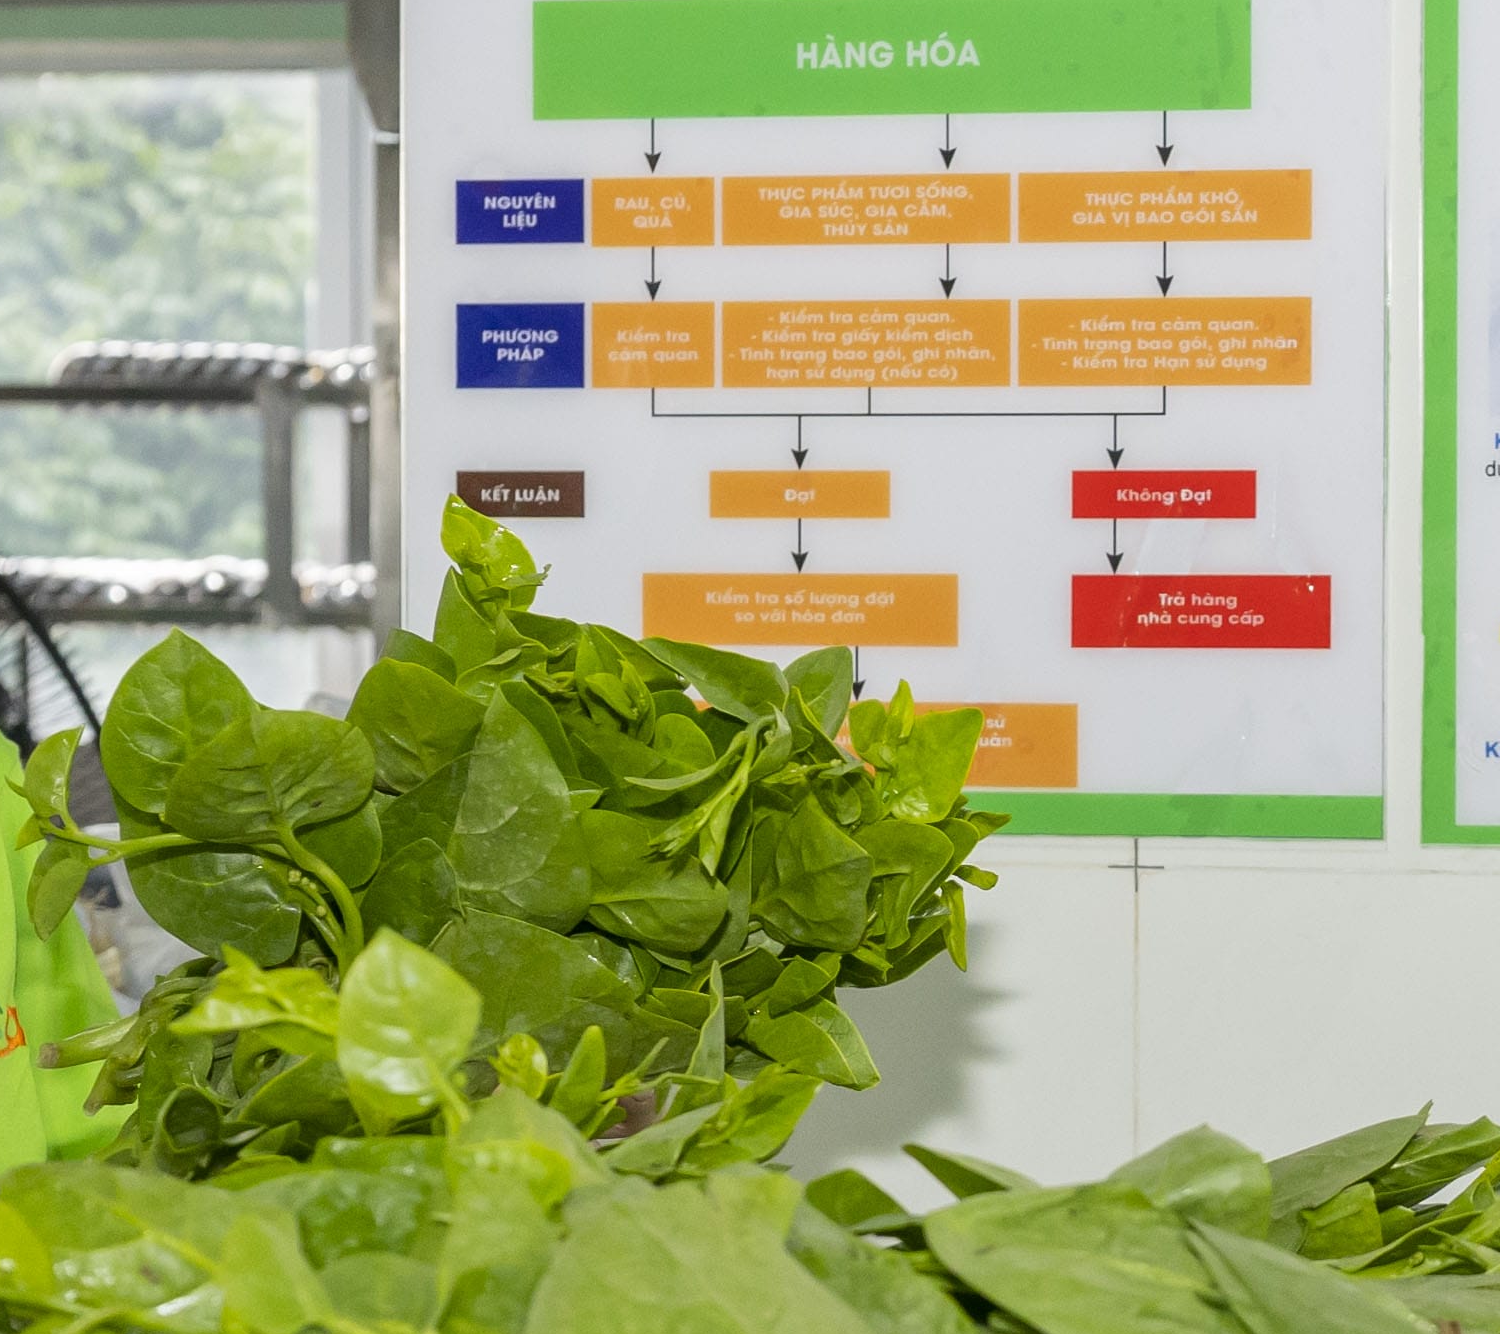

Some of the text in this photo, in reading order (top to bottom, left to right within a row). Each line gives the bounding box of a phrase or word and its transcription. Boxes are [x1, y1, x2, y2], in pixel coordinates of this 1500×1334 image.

[797, 31, 980, 69] HÀNG HÓA
[484, 192, 556, 210] NGUYÊN
[503, 214, 537, 231] LIỆU
[482, 329, 559, 344] PHƯƠNG
[497, 347, 544, 361] PHÁP
[481, 483, 560, 508] KẾT LUẬN
[1116, 487, 1212, 506] Không Đạt
[1159, 591, 1238, 609] Trả hàng
[1137, 609, 1264, 628] nhà cung cấp
